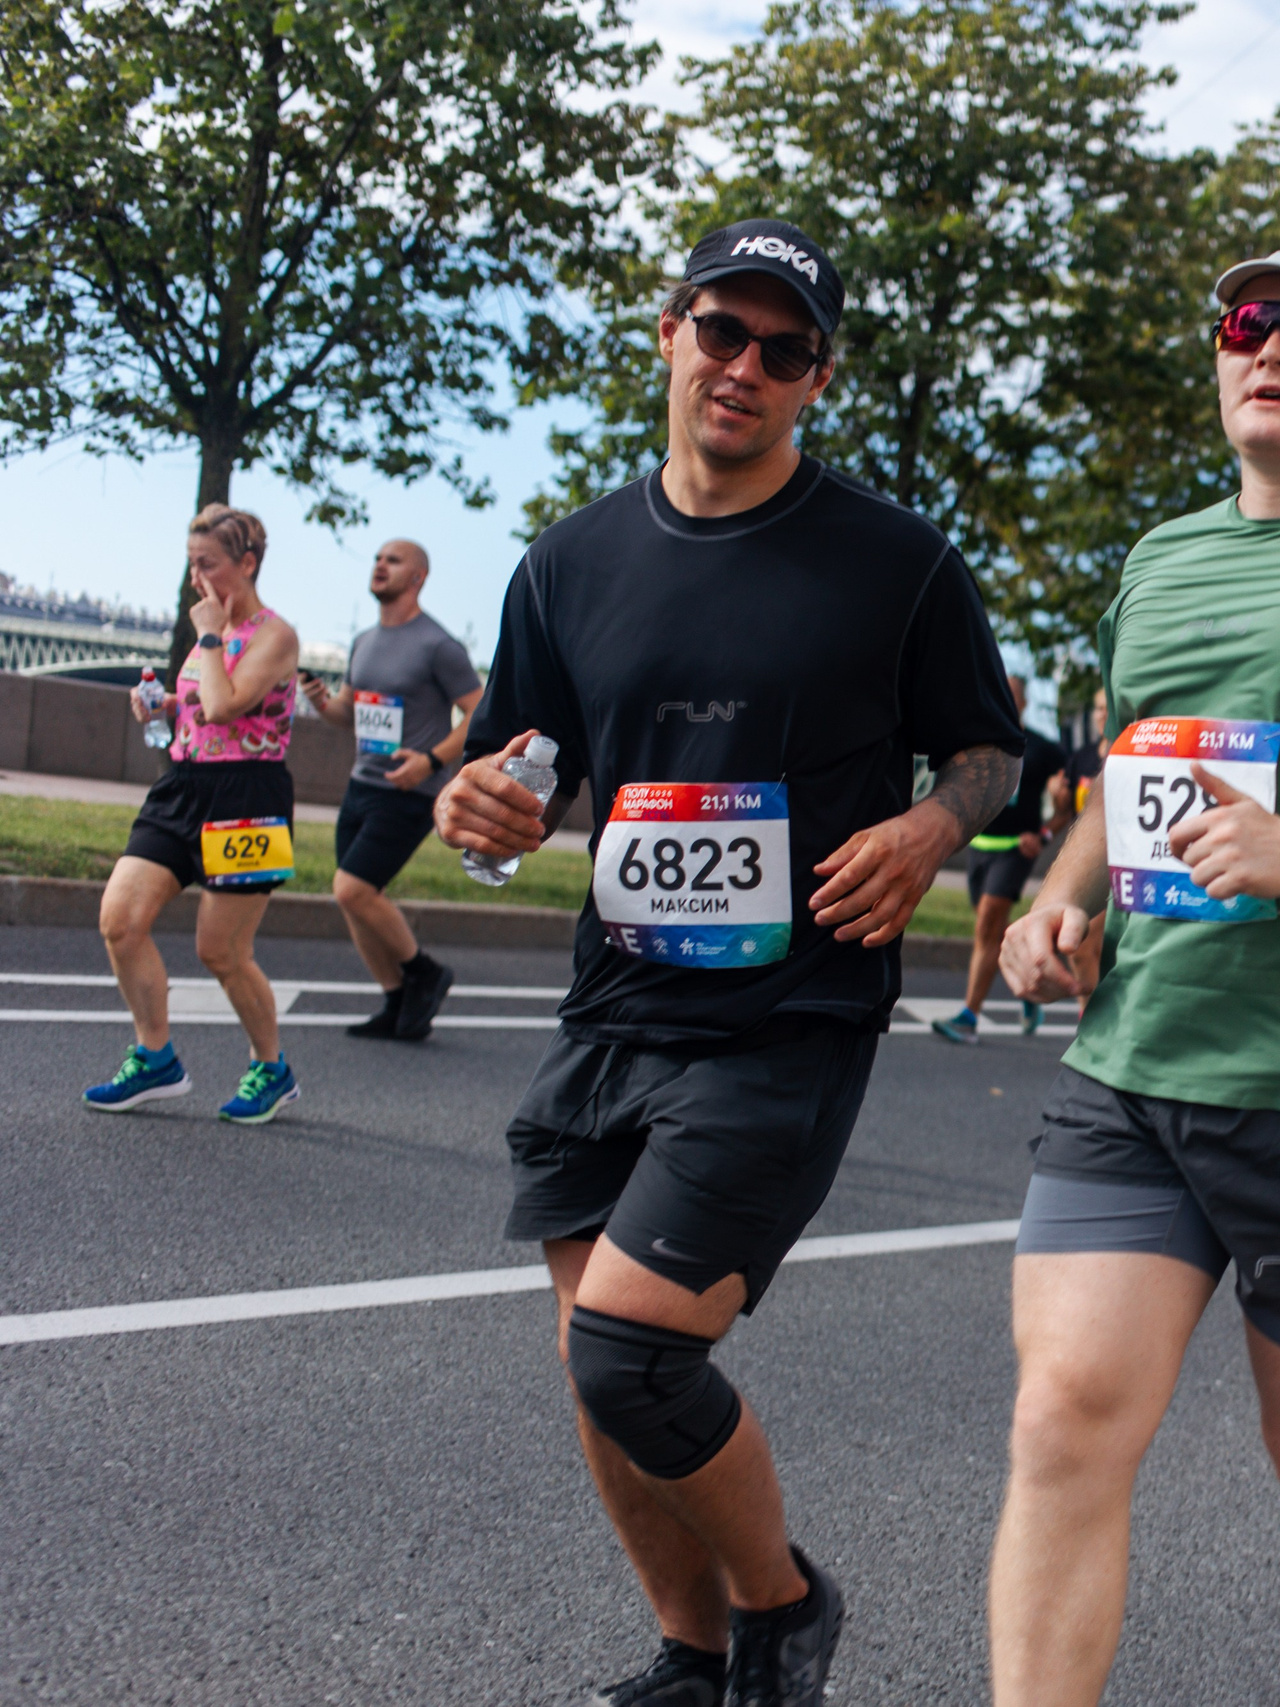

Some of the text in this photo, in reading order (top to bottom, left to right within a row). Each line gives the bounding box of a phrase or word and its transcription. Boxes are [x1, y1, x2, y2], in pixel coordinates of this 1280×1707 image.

[730, 235, 819, 286] HOKA
[1198, 730, 1225, 749] 21,1
[622, 798, 674, 810] МАРАФОН
[700, 794, 730, 812] 21,1
[223, 833, 270, 860] 629
[618, 837, 763, 891] 6823
[650, 897, 729, 913] МАКСИМ
